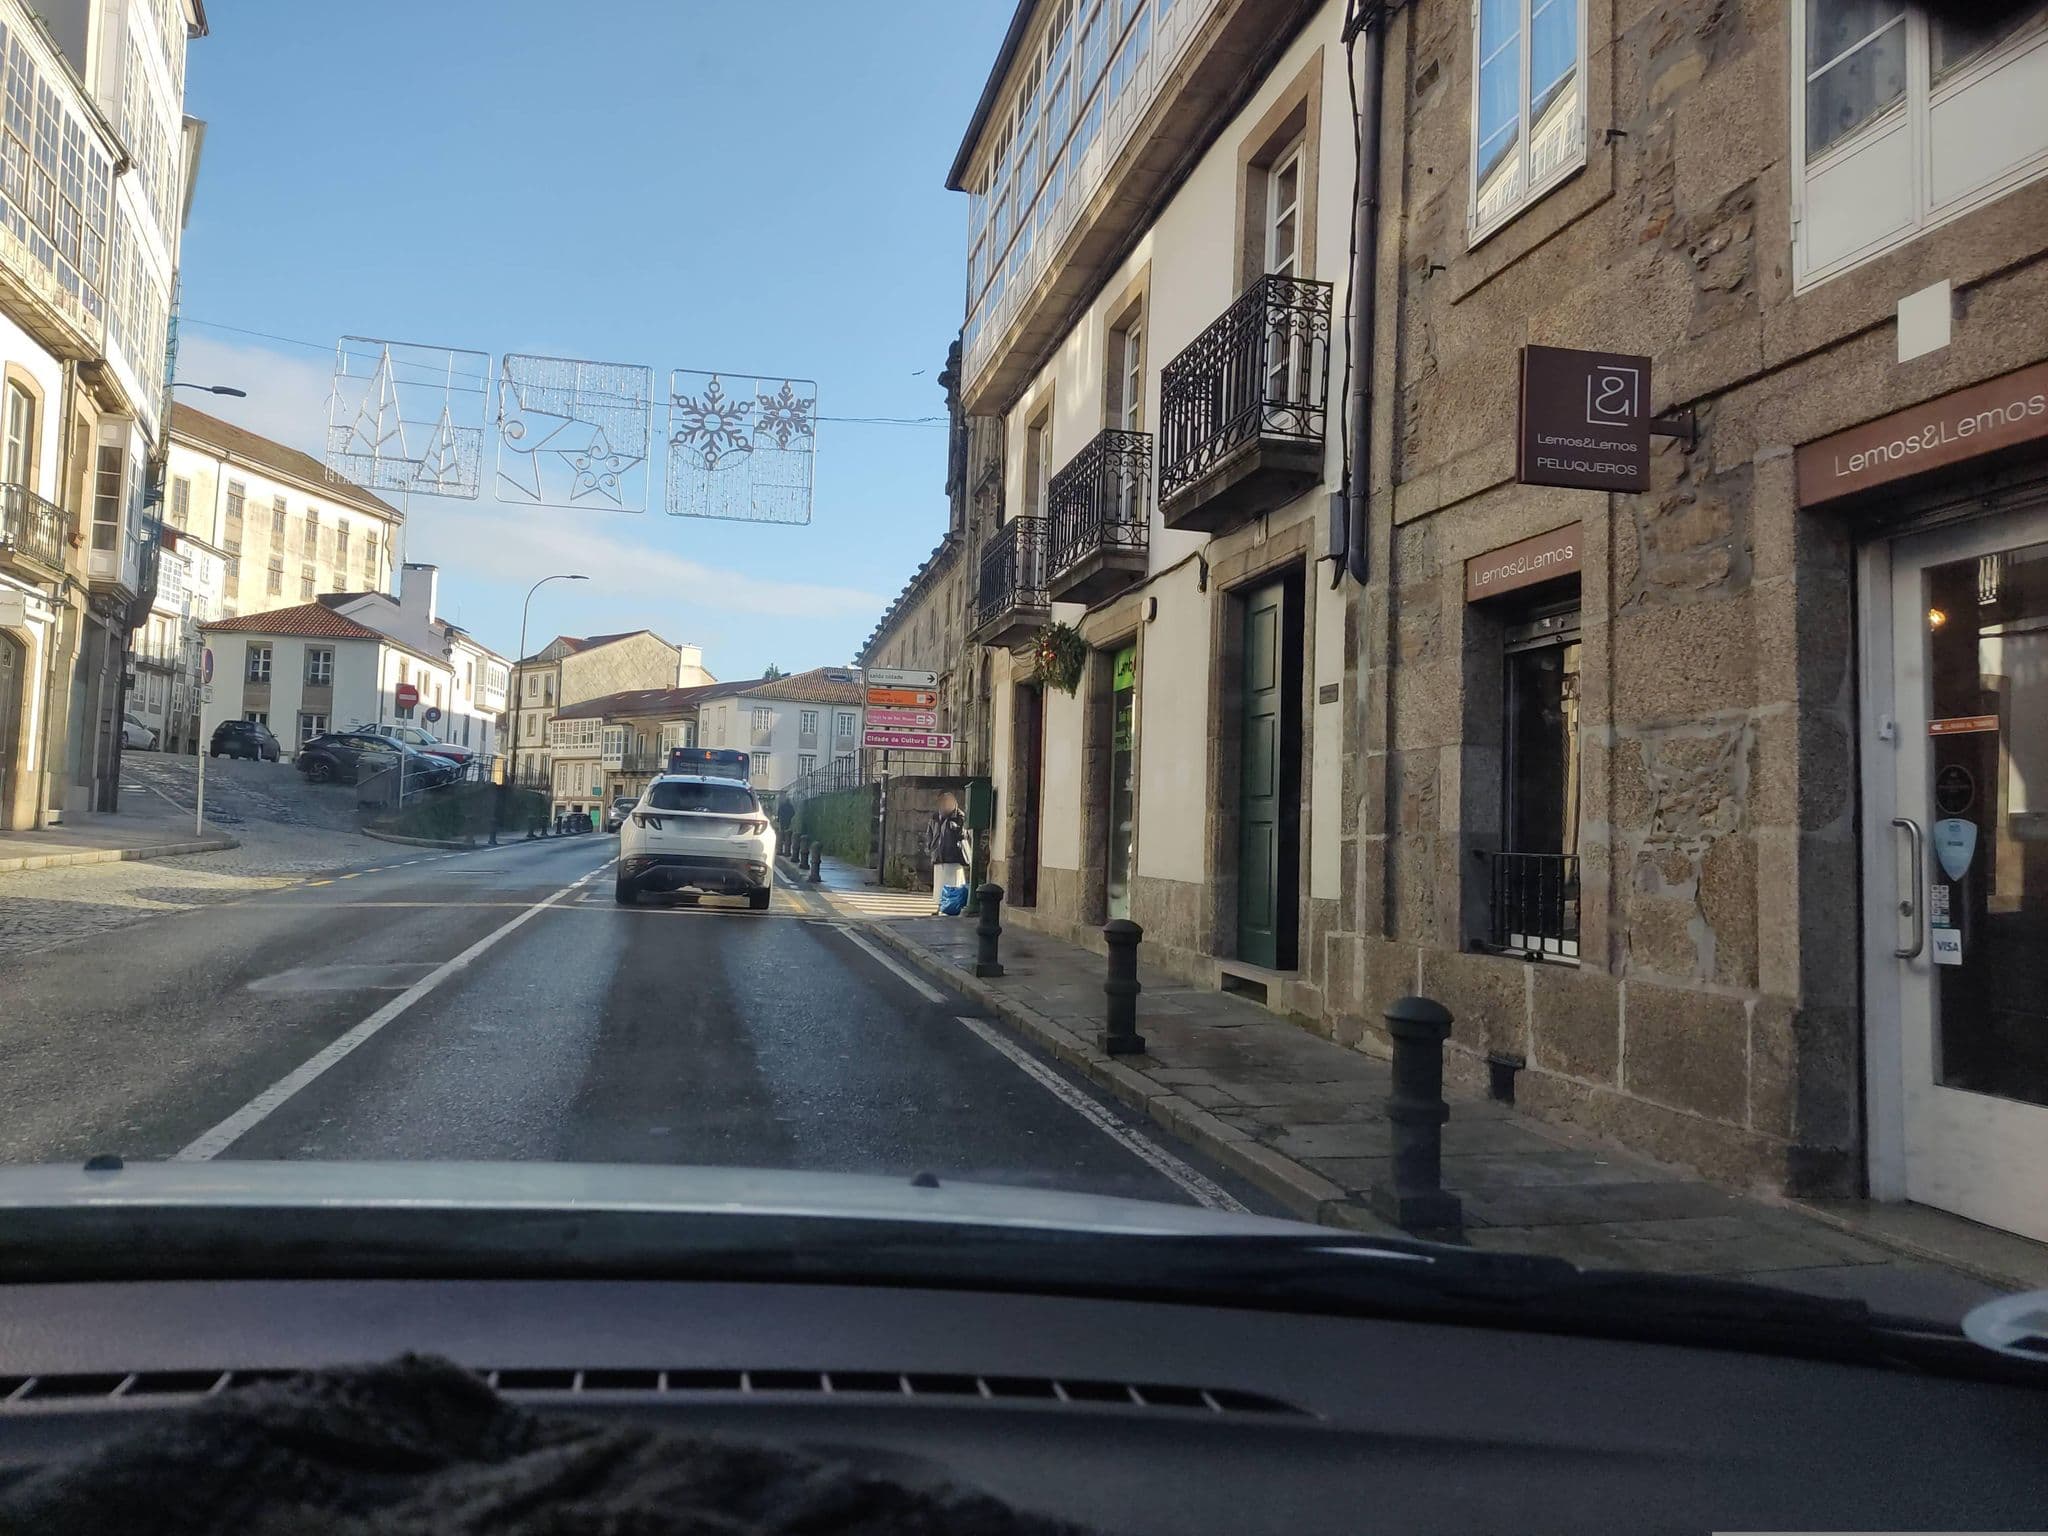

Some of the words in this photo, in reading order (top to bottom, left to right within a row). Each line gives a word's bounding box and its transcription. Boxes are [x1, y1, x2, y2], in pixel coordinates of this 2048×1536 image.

[1537, 433, 1638, 452] Lemos&Lemos
[1834, 394, 2047, 478] Lemos&Lemos
[1537, 457, 1638, 476] PELUQUEROS
[1474, 545, 1574, 586] Lemos&Lemos
[866, 735, 889, 743] Cidade
[1936, 941, 1960, 953] VISA
